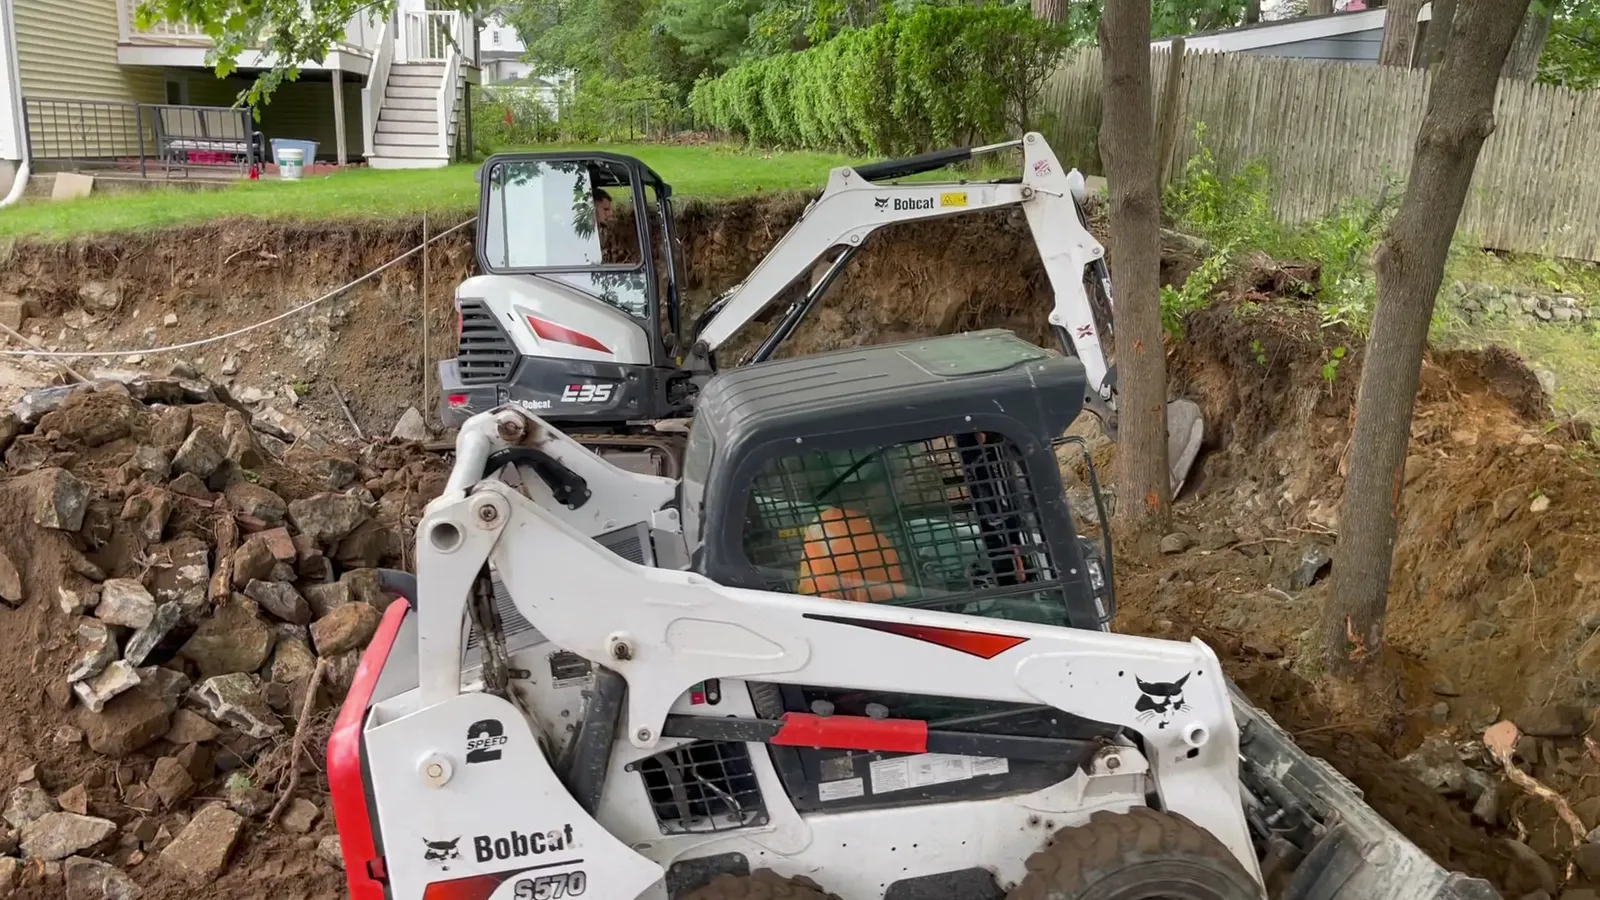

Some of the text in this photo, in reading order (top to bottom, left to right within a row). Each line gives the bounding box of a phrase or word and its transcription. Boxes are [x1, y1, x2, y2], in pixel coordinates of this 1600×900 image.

[894, 197, 934, 211] Bobcat
[522, 399, 551, 409] Bobcat
[466, 736, 508, 750] SPEED
[474, 823, 575, 863] Bobcat
[514, 870, 586, 900] S570
